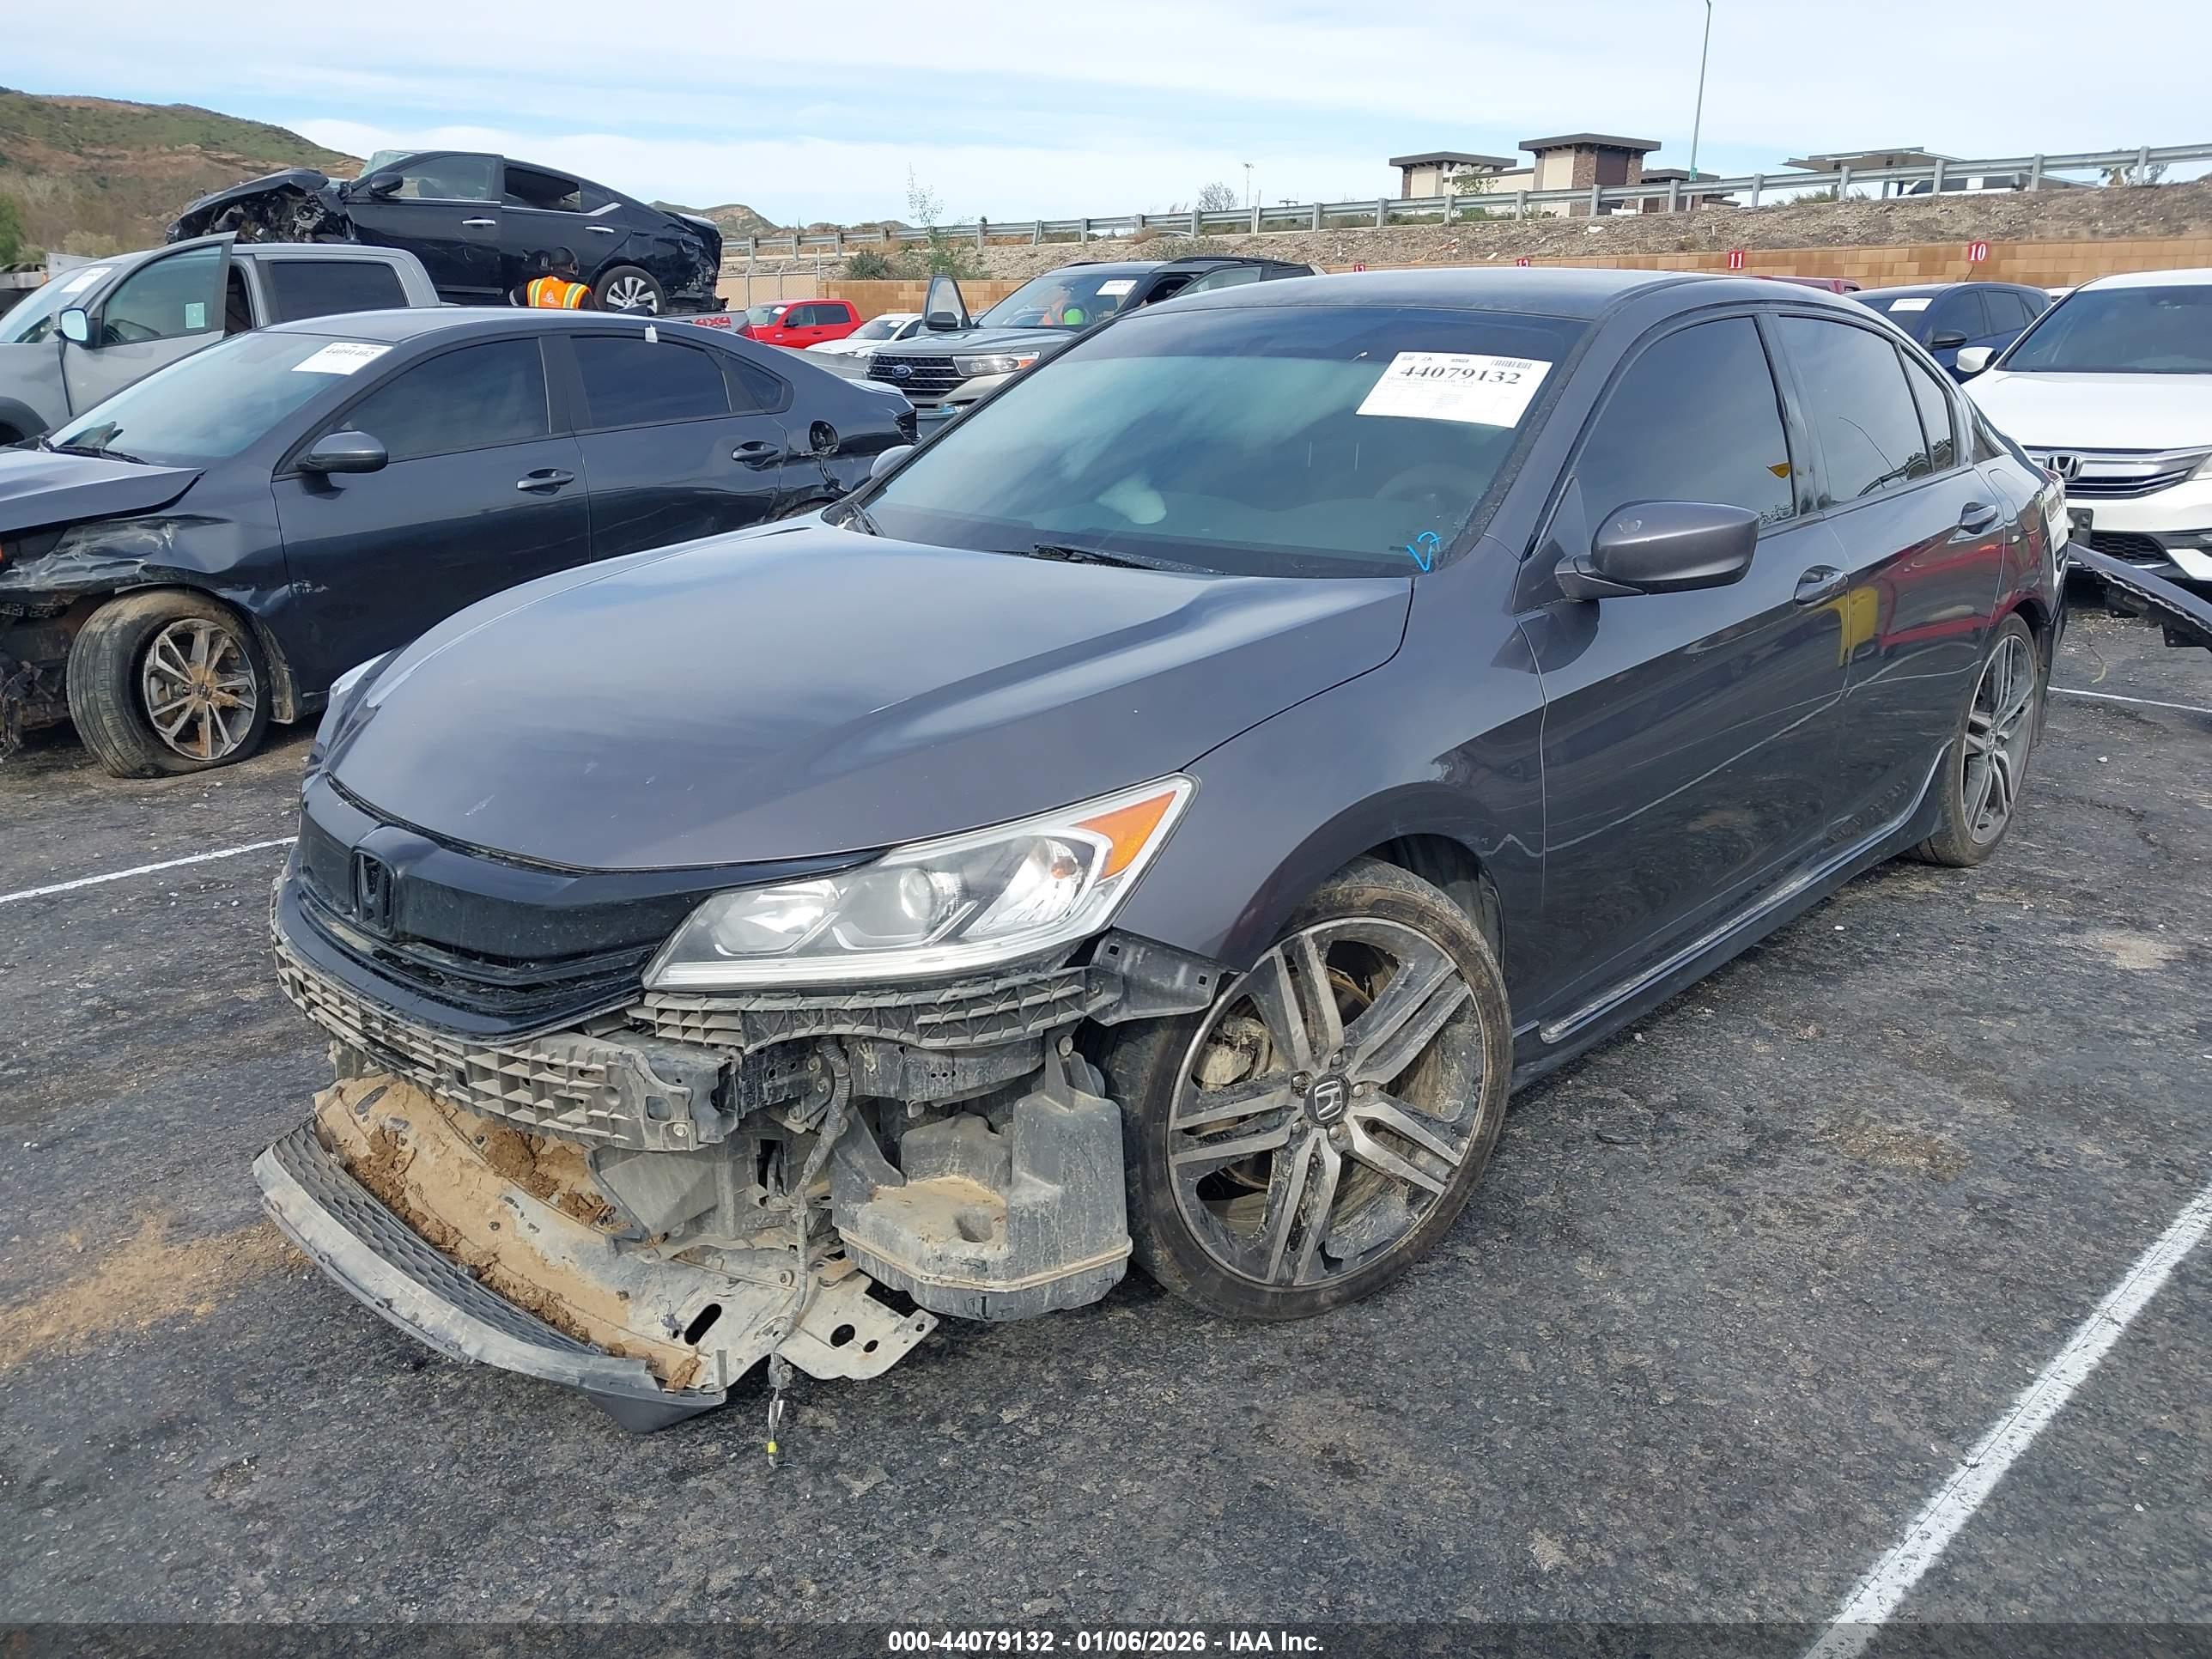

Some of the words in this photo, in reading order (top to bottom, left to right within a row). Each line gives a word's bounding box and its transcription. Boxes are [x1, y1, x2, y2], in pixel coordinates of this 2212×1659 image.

[1729, 252, 1742, 269] 11
[1968, 243, 1987, 261] 10
[1400, 365, 1522, 385] 44079132
